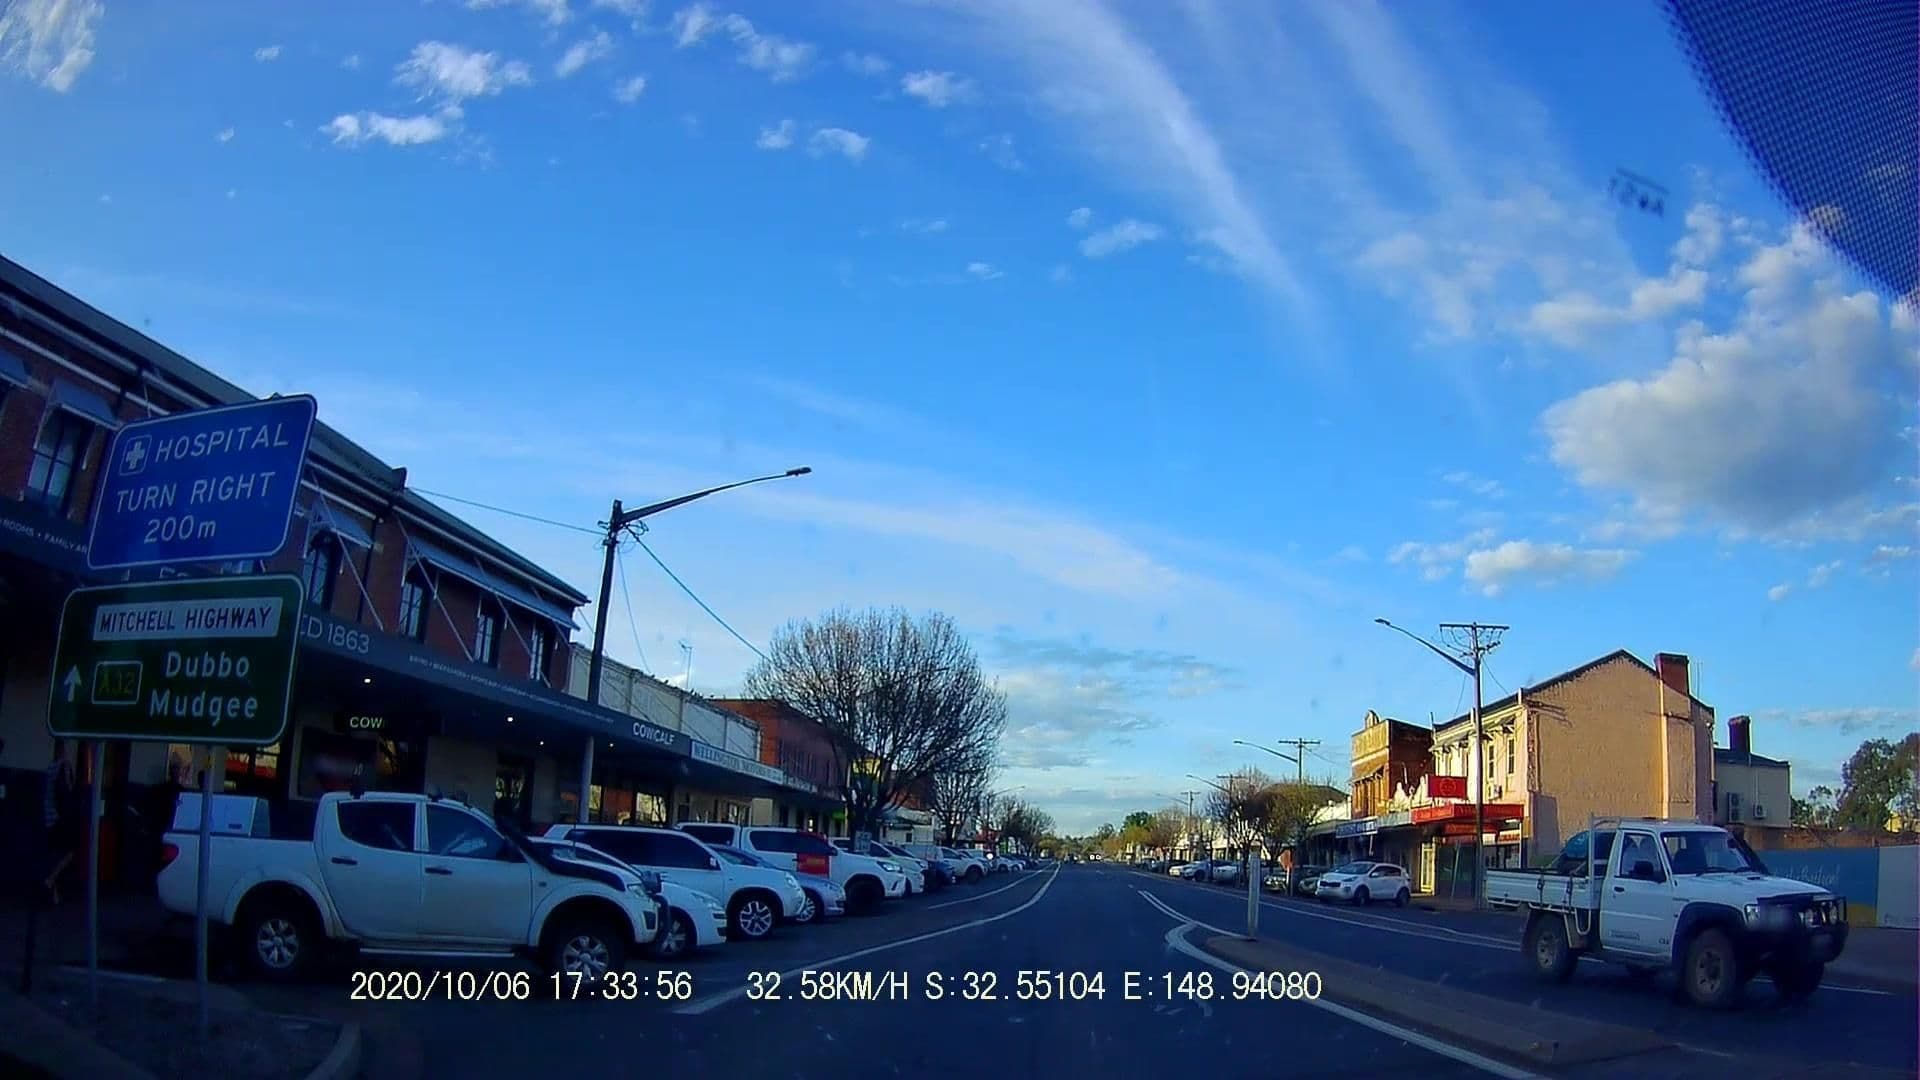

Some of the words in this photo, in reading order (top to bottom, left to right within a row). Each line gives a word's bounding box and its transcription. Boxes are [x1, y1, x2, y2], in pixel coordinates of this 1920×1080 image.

[154, 423, 290, 463] HOSPITAL
[116, 483, 177, 513] TURN
[190, 471, 276, 506] RIGHT
[143, 515, 216, 544] 200m
[99, 608, 176, 632] MITCHELL
[184, 606, 272, 630] HIGHWAY
[327, 623, 370, 654] 1863
[165, 650, 250, 678] Dubbo
[149, 687, 258, 727] Mudgee
[349, 716, 383, 729] COW
